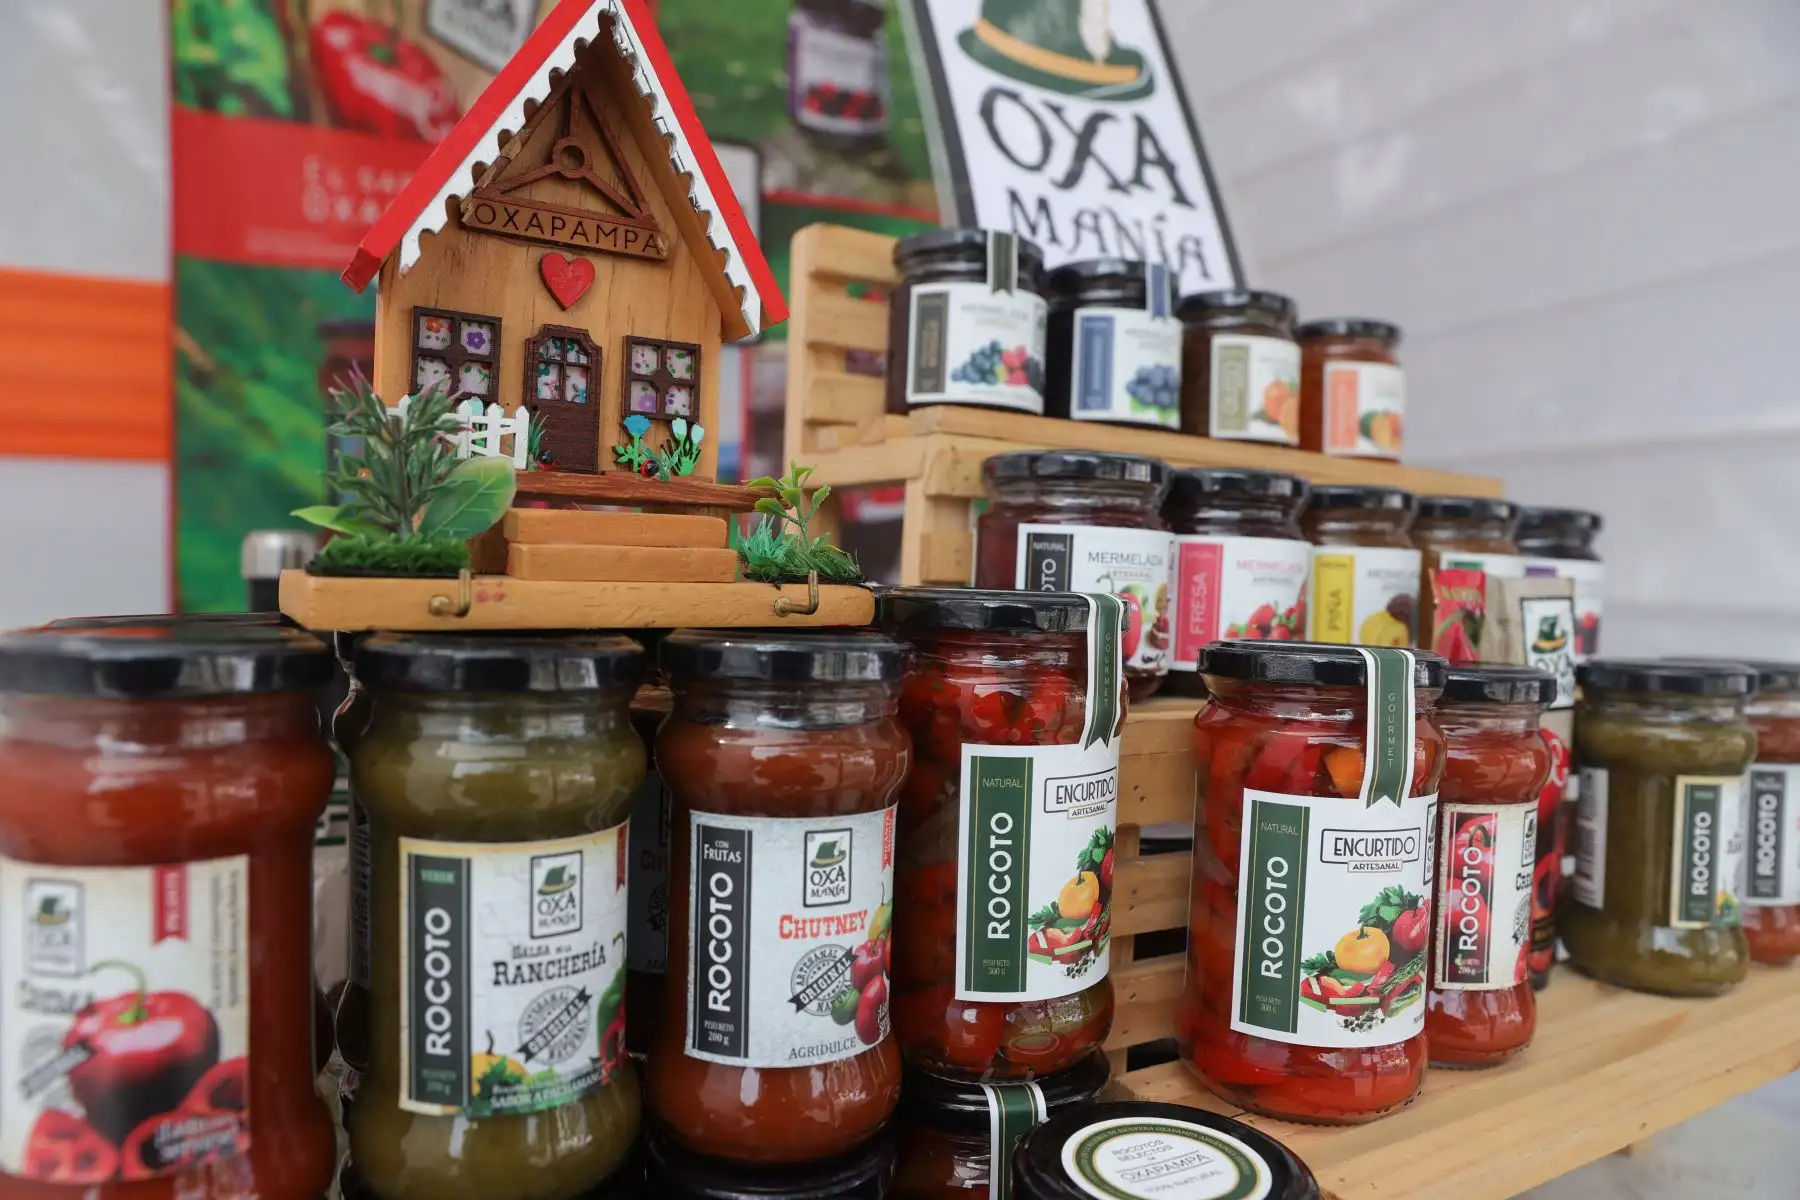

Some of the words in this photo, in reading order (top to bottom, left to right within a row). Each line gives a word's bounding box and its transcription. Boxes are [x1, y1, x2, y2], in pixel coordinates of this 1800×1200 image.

[978, 86, 1197, 209] OXA
[474, 203, 662, 256] OXAPAMPA
[1190, 571, 1208, 635] FRESA
[1102, 632, 1112, 707] GOURMET
[1387, 692, 1396, 768] GOURMET
[982, 777, 1022, 789] NATURAL
[1056, 775, 1115, 805] ENCURTIDO
[1071, 803, 1106, 818] ARTESANAL
[714, 839, 730, 849] CON
[1260, 822, 1299, 836] NATURAL
[1333, 836, 1416, 858] ENCURTIDO
[1756, 793, 1778, 877] ROCOTO
[703, 843, 742, 864] FRUTAS
[1352, 862, 1400, 872] ARTESANAL
[1691, 811, 1713, 896] ROCOTO
[810, 865, 847, 888] OXA
[987, 811, 1014, 940] ROCOTO
[537, 891, 577, 917] OXA
[1458, 845, 1484, 951] ROCOTO
[779, 908, 869, 941] CHUTNEY
[1260, 856, 1289, 980] ROCOTO
[707, 871, 733, 1013] ROCOTO
[492, 940, 607, 987] RANCHERÍA
[796, 948, 838, 988] ARTESANAL
[800, 957, 851, 1004] ORIGINAL
[424, 907, 452, 1057] ROCOTO
[788, 1036, 858, 1061] AGRIDULCE
[1111, 1139, 1164, 1156] ROCOTOS
[1117, 1144, 1174, 1162] SELECTOS
[1120, 1153, 1210, 1181] OXAPAMPA
